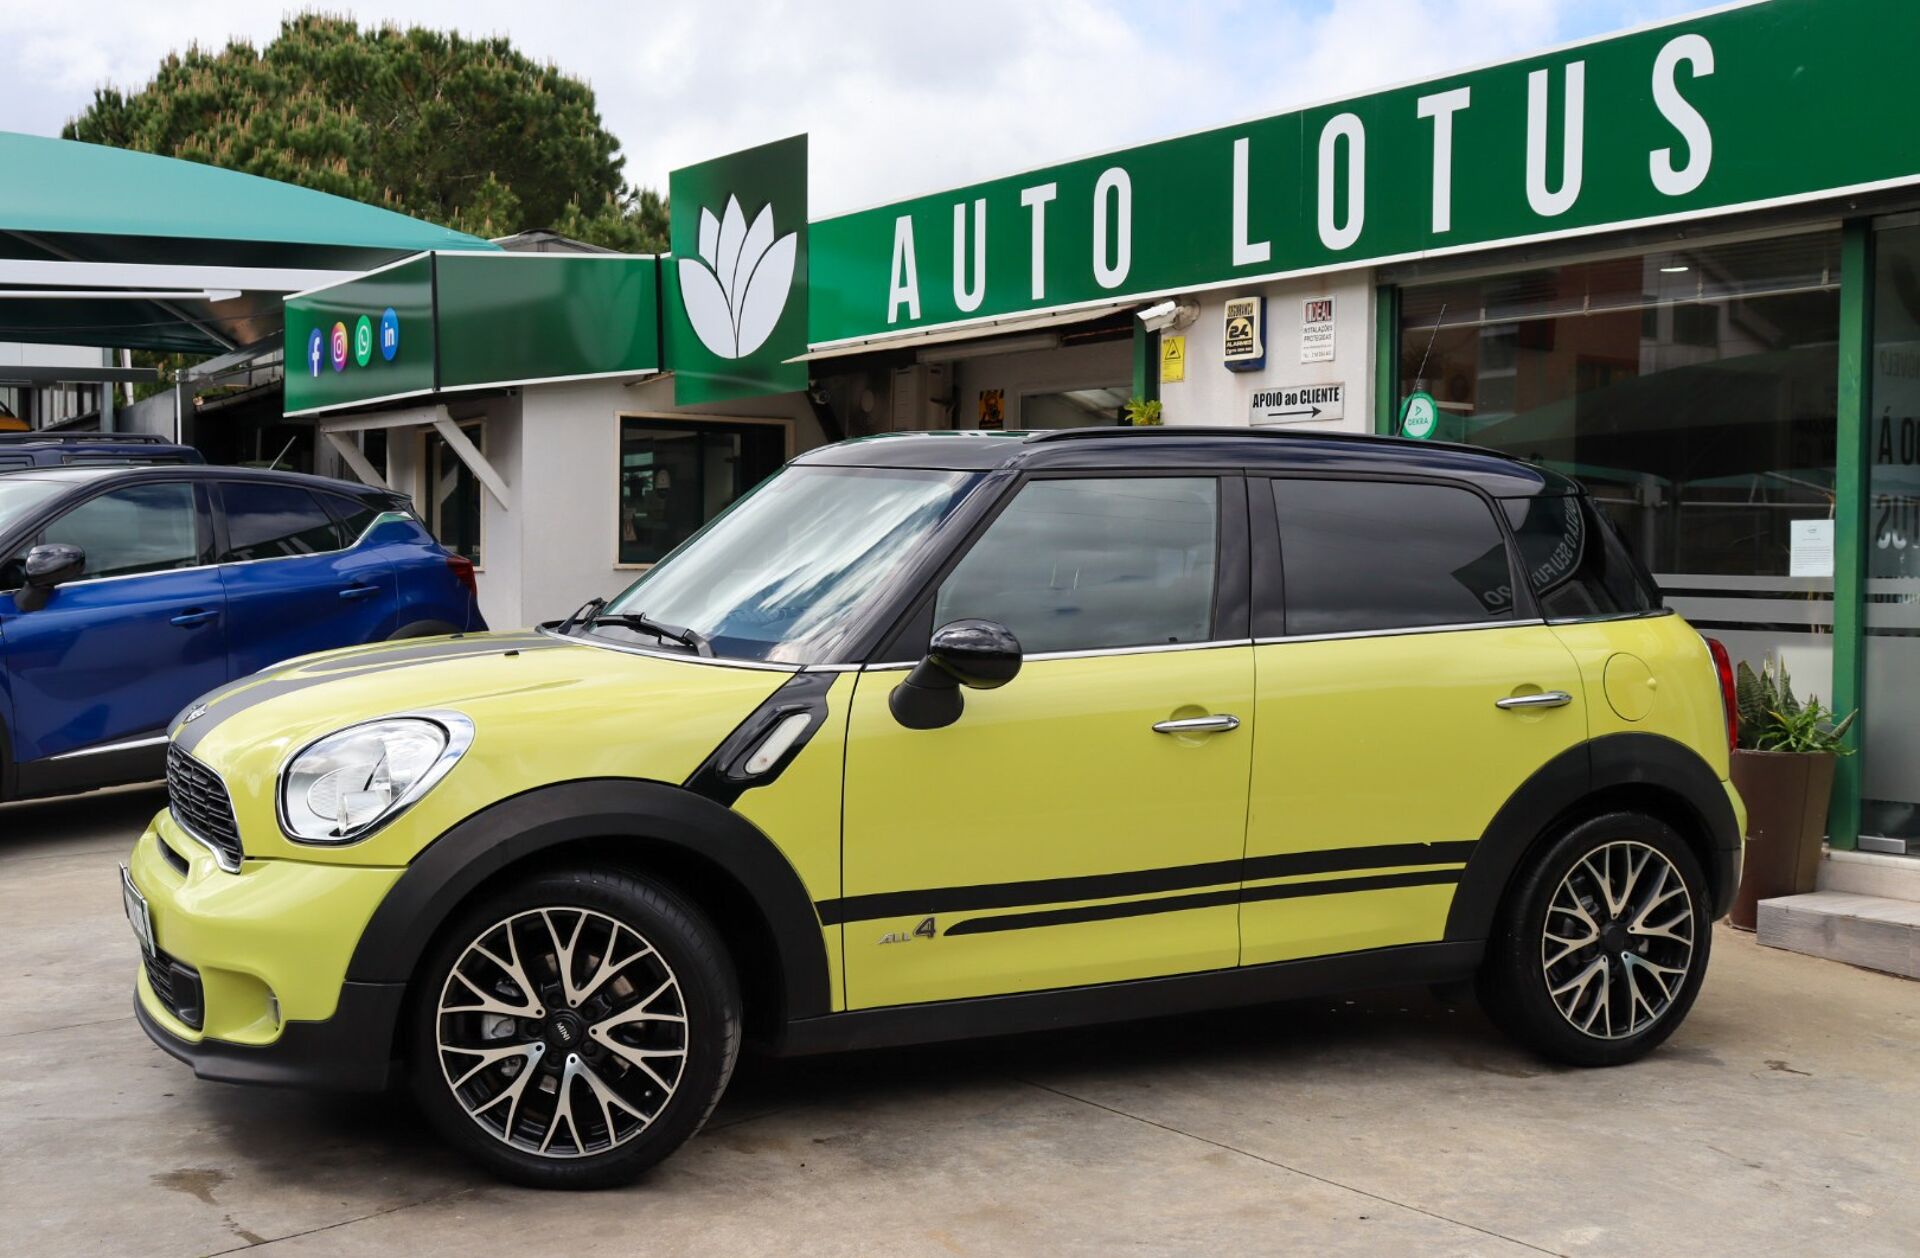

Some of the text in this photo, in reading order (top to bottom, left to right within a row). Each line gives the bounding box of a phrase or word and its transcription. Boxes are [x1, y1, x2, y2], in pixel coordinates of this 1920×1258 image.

[886, 33, 1715, 324] AUTO LOTUS
[1252, 386, 1340, 408] APOIO ao CLIENTE
[556, 1021, 571, 1040] MINI
